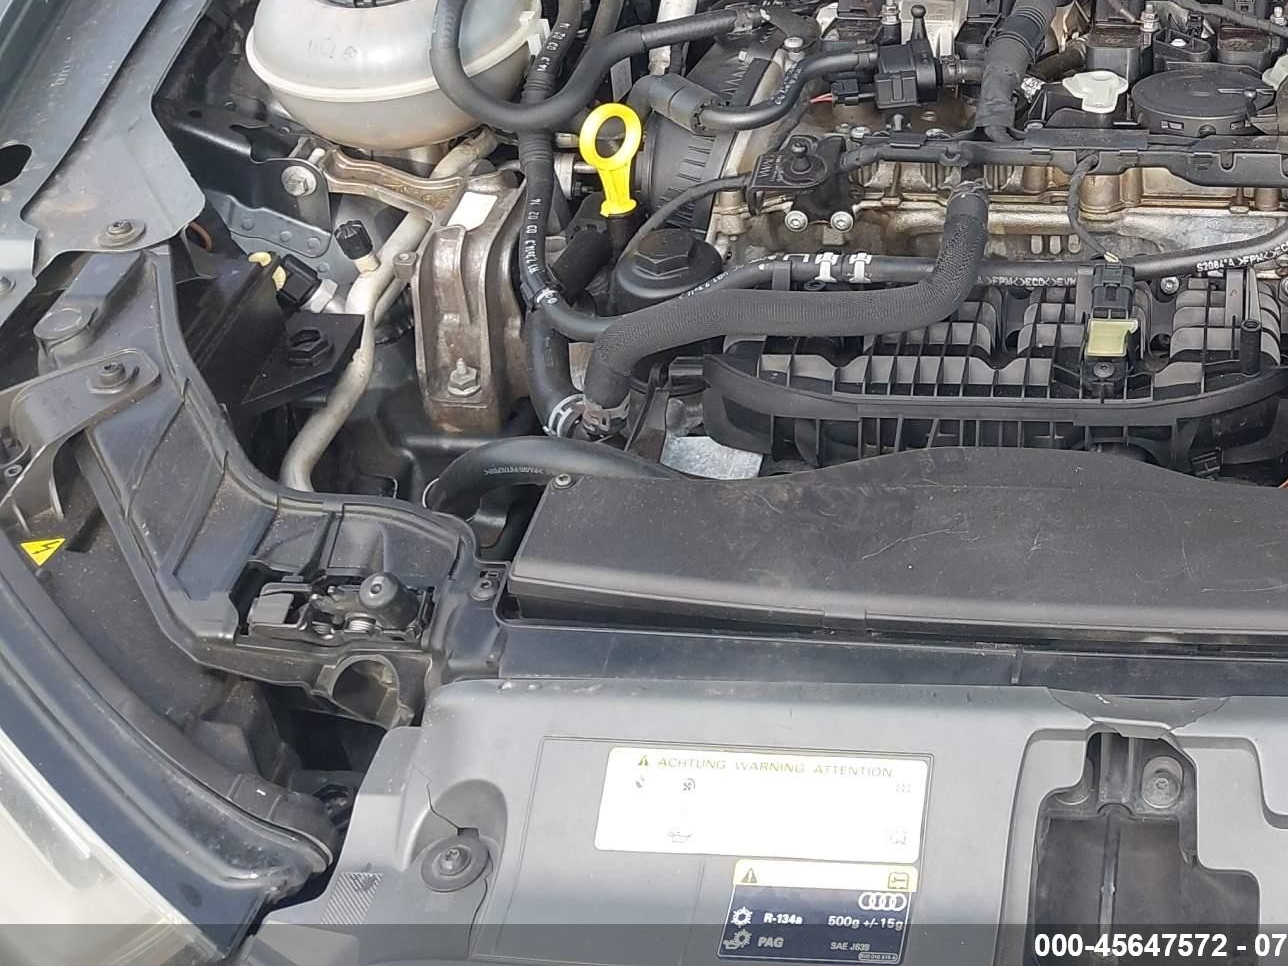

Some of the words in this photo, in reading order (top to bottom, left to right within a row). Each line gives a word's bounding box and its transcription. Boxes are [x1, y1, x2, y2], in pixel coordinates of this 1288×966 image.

[658, 758, 727, 771] ACHTUNG
[735, 761, 805, 774] WARNING
[764, 912, 803, 925] R-134a
[828, 915, 860, 929] 500g
[758, 936, 784, 948] PAG
[830, 942, 848, 950] SAE
[849, 942, 870, 952] J639
